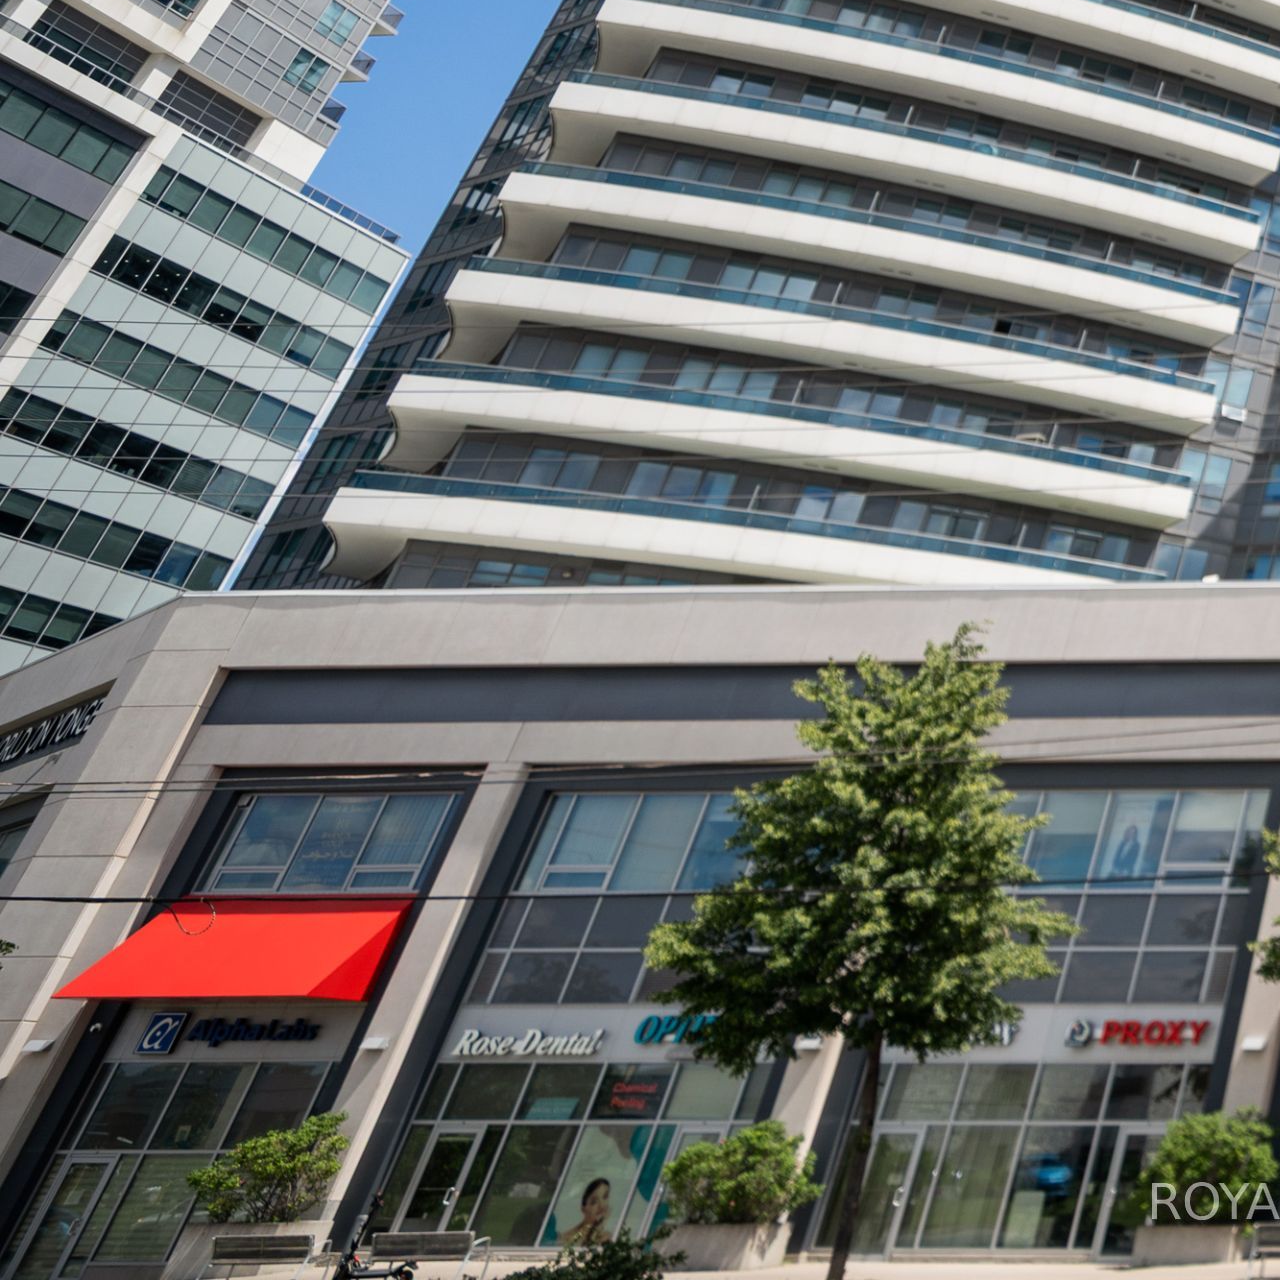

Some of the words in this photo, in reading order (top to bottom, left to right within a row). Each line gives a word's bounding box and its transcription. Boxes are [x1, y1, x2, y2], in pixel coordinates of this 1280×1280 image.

[25, 717, 60, 754] ON
[48, 698, 104, 745] YONGE
[187, 1019, 266, 1048] Alpha
[264, 1019, 321, 1041] Labs
[452, 1029, 515, 1056] Rose
[513, 1028, 605, 1057] Dental
[1100, 1020, 1211, 1046] PROXY
